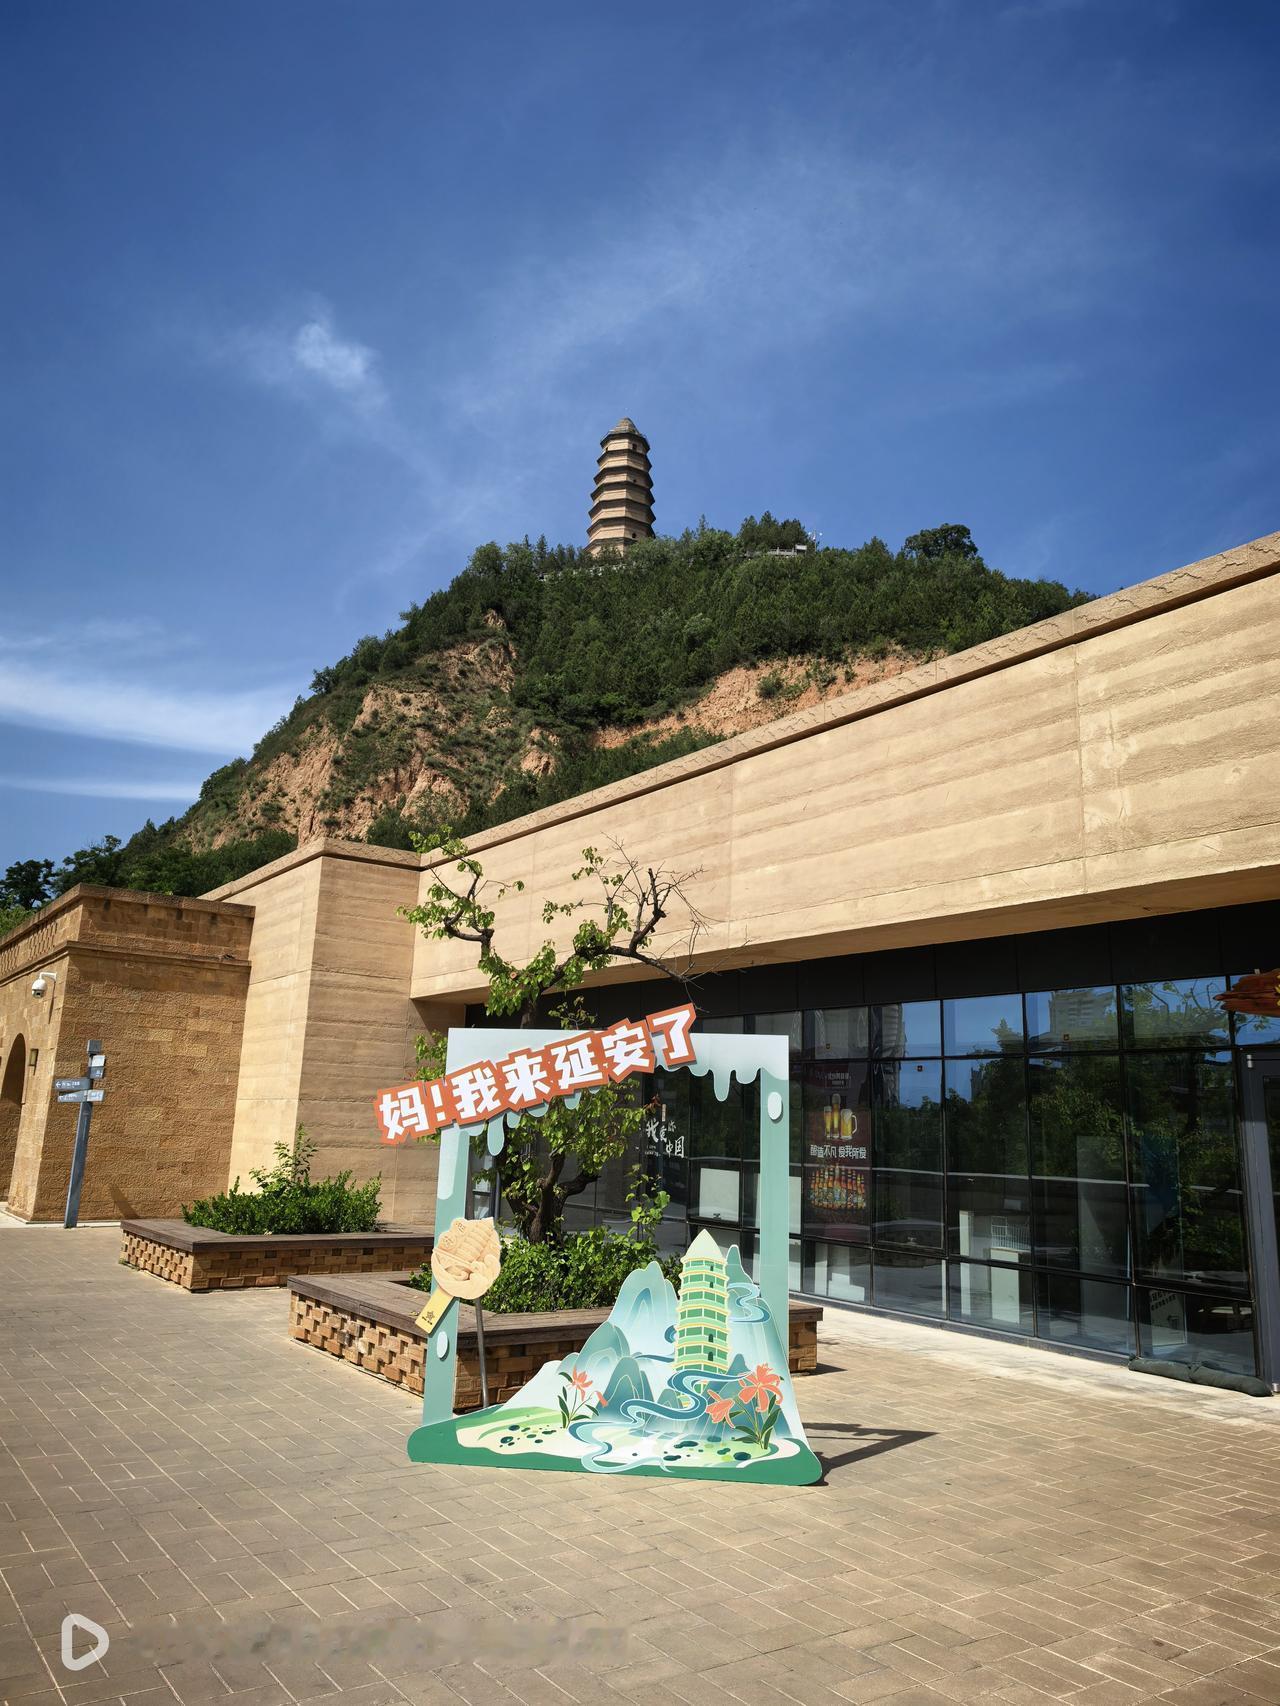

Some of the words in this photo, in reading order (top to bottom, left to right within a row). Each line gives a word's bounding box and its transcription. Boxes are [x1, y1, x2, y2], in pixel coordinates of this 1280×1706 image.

[379, 1009, 691, 1140] 妈!我来延安了
